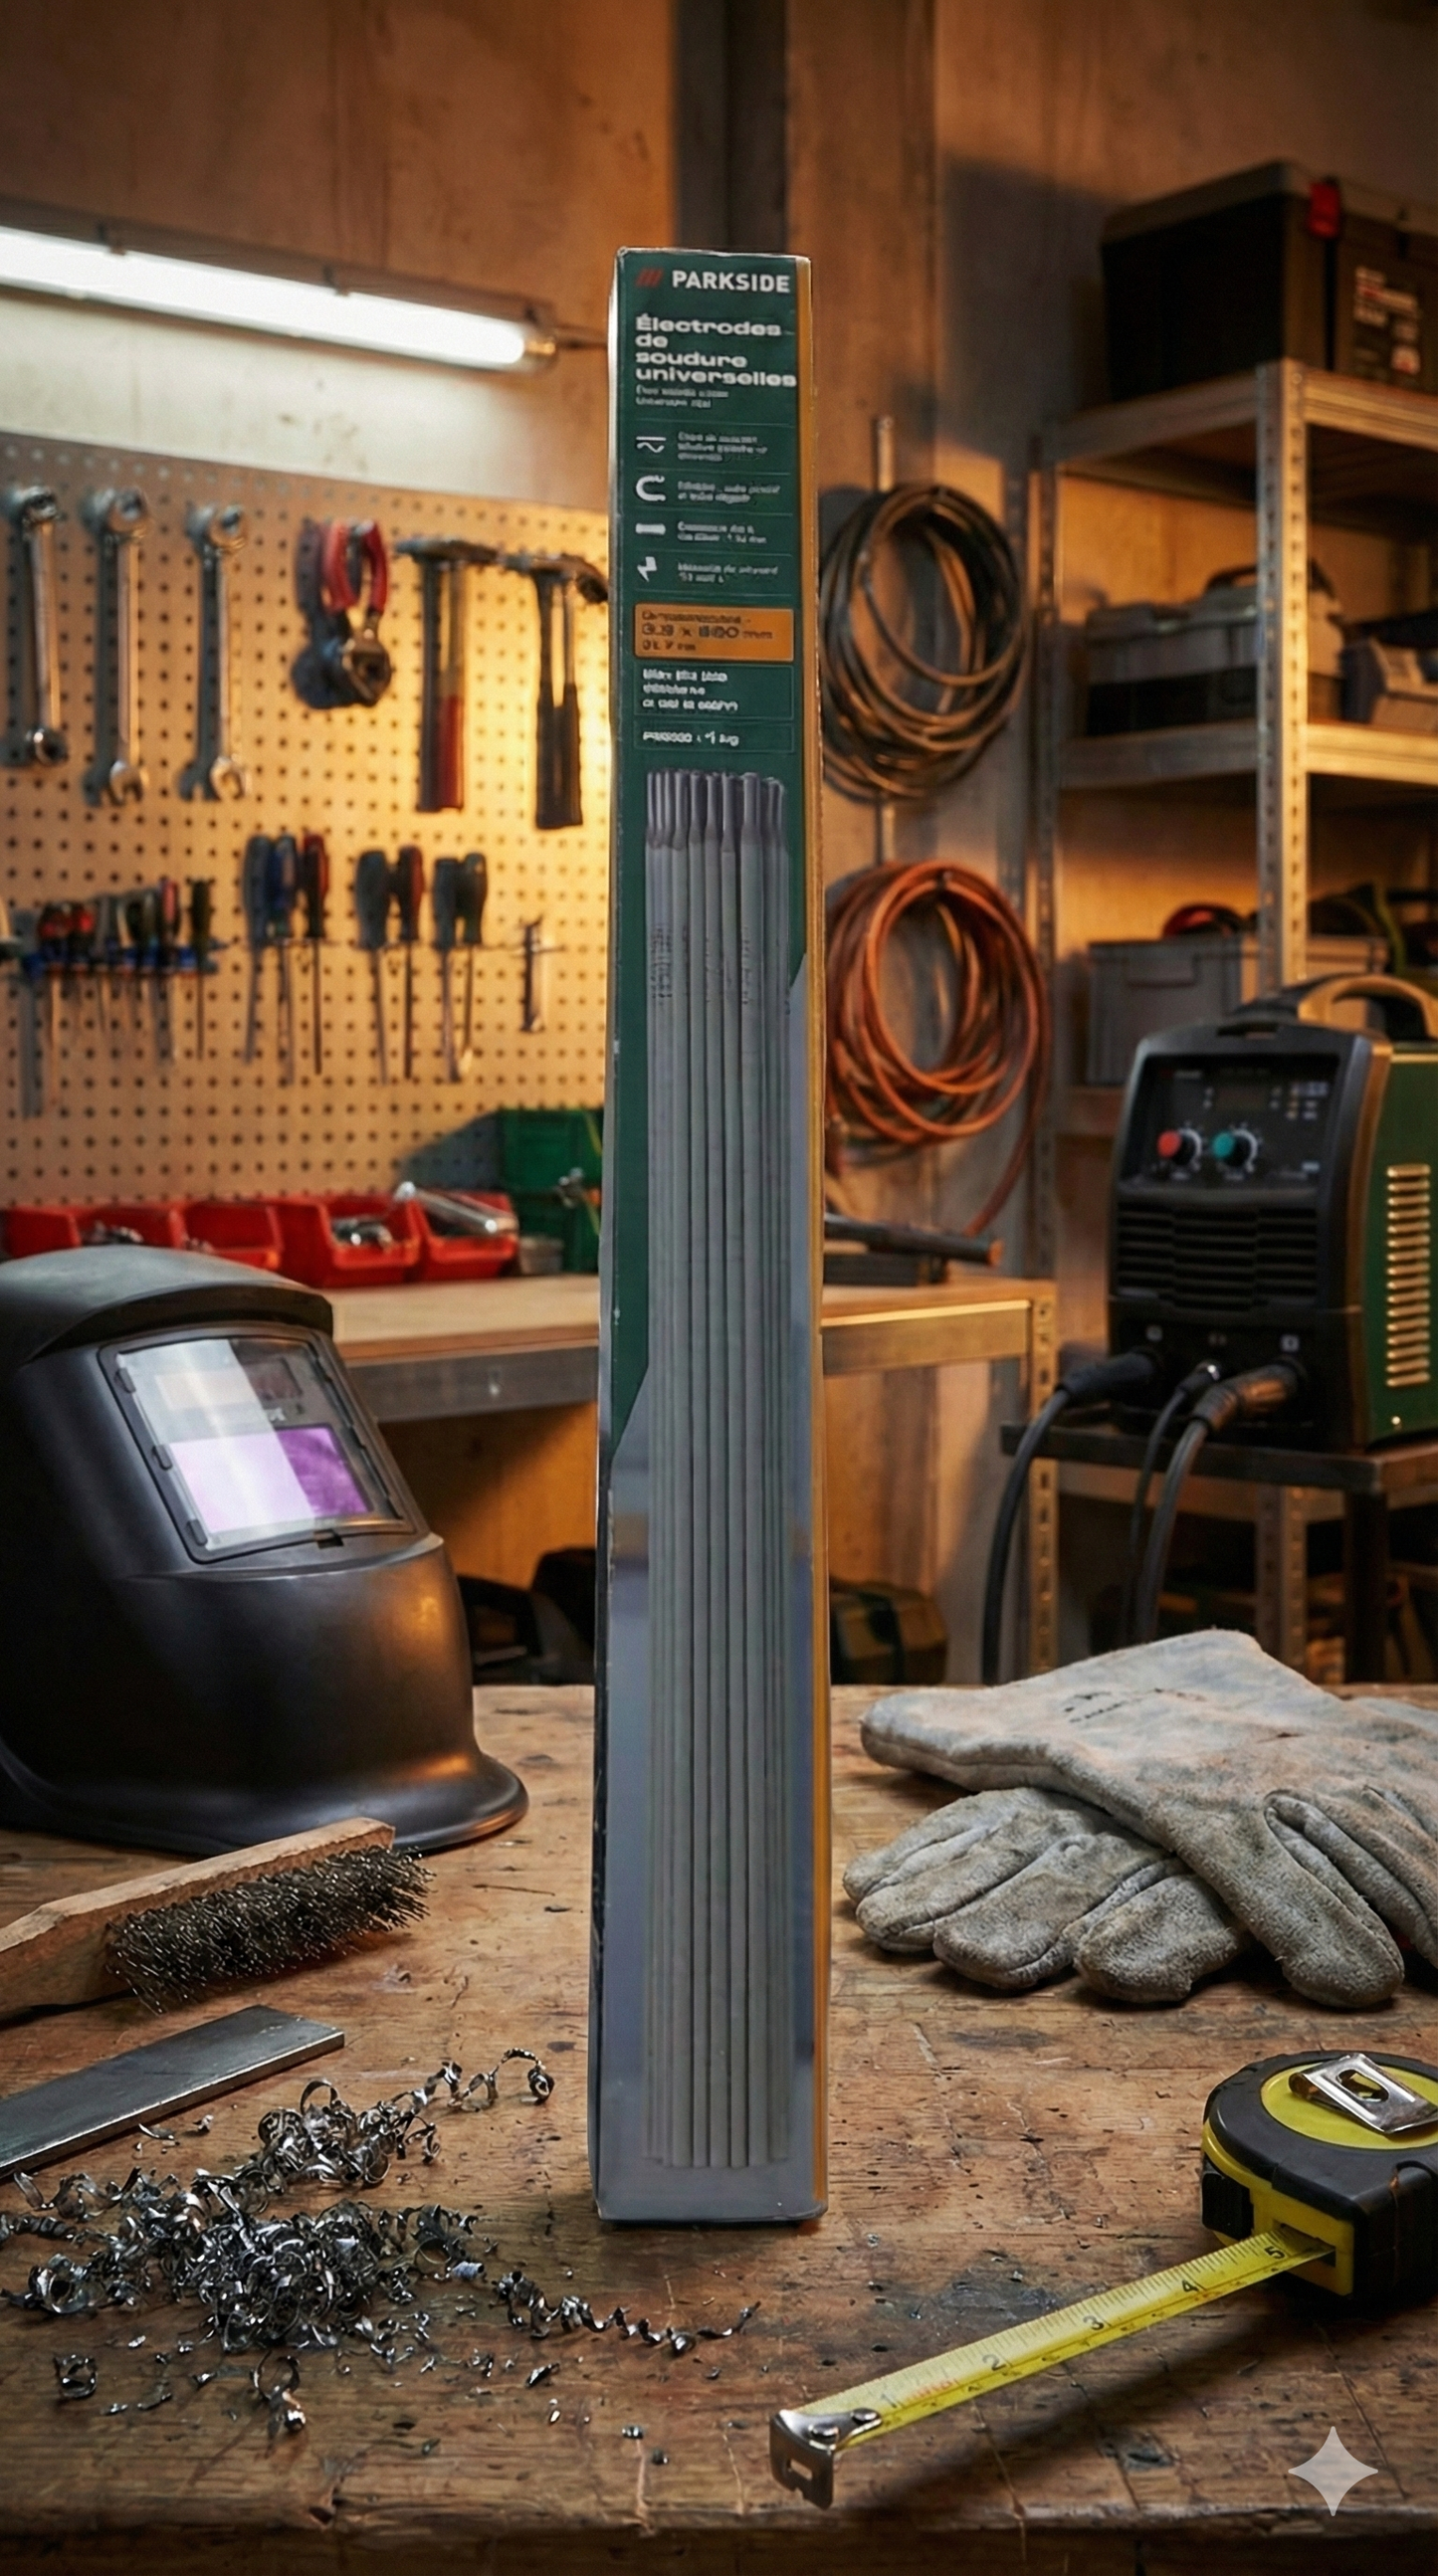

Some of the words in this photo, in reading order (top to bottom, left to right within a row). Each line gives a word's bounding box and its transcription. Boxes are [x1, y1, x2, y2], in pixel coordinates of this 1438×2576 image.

[672, 270, 791, 294] PARKSIDE
[635, 313, 782, 336] Électrodes
[635, 351, 747, 368] soudure
[635, 366, 797, 388] universelles
[981, 2354, 1007, 2372] 2
[1083, 2314, 1105, 2331] 3
[1181, 2279, 1199, 2293] 4
[1264, 2246, 1286, 2261] 5
